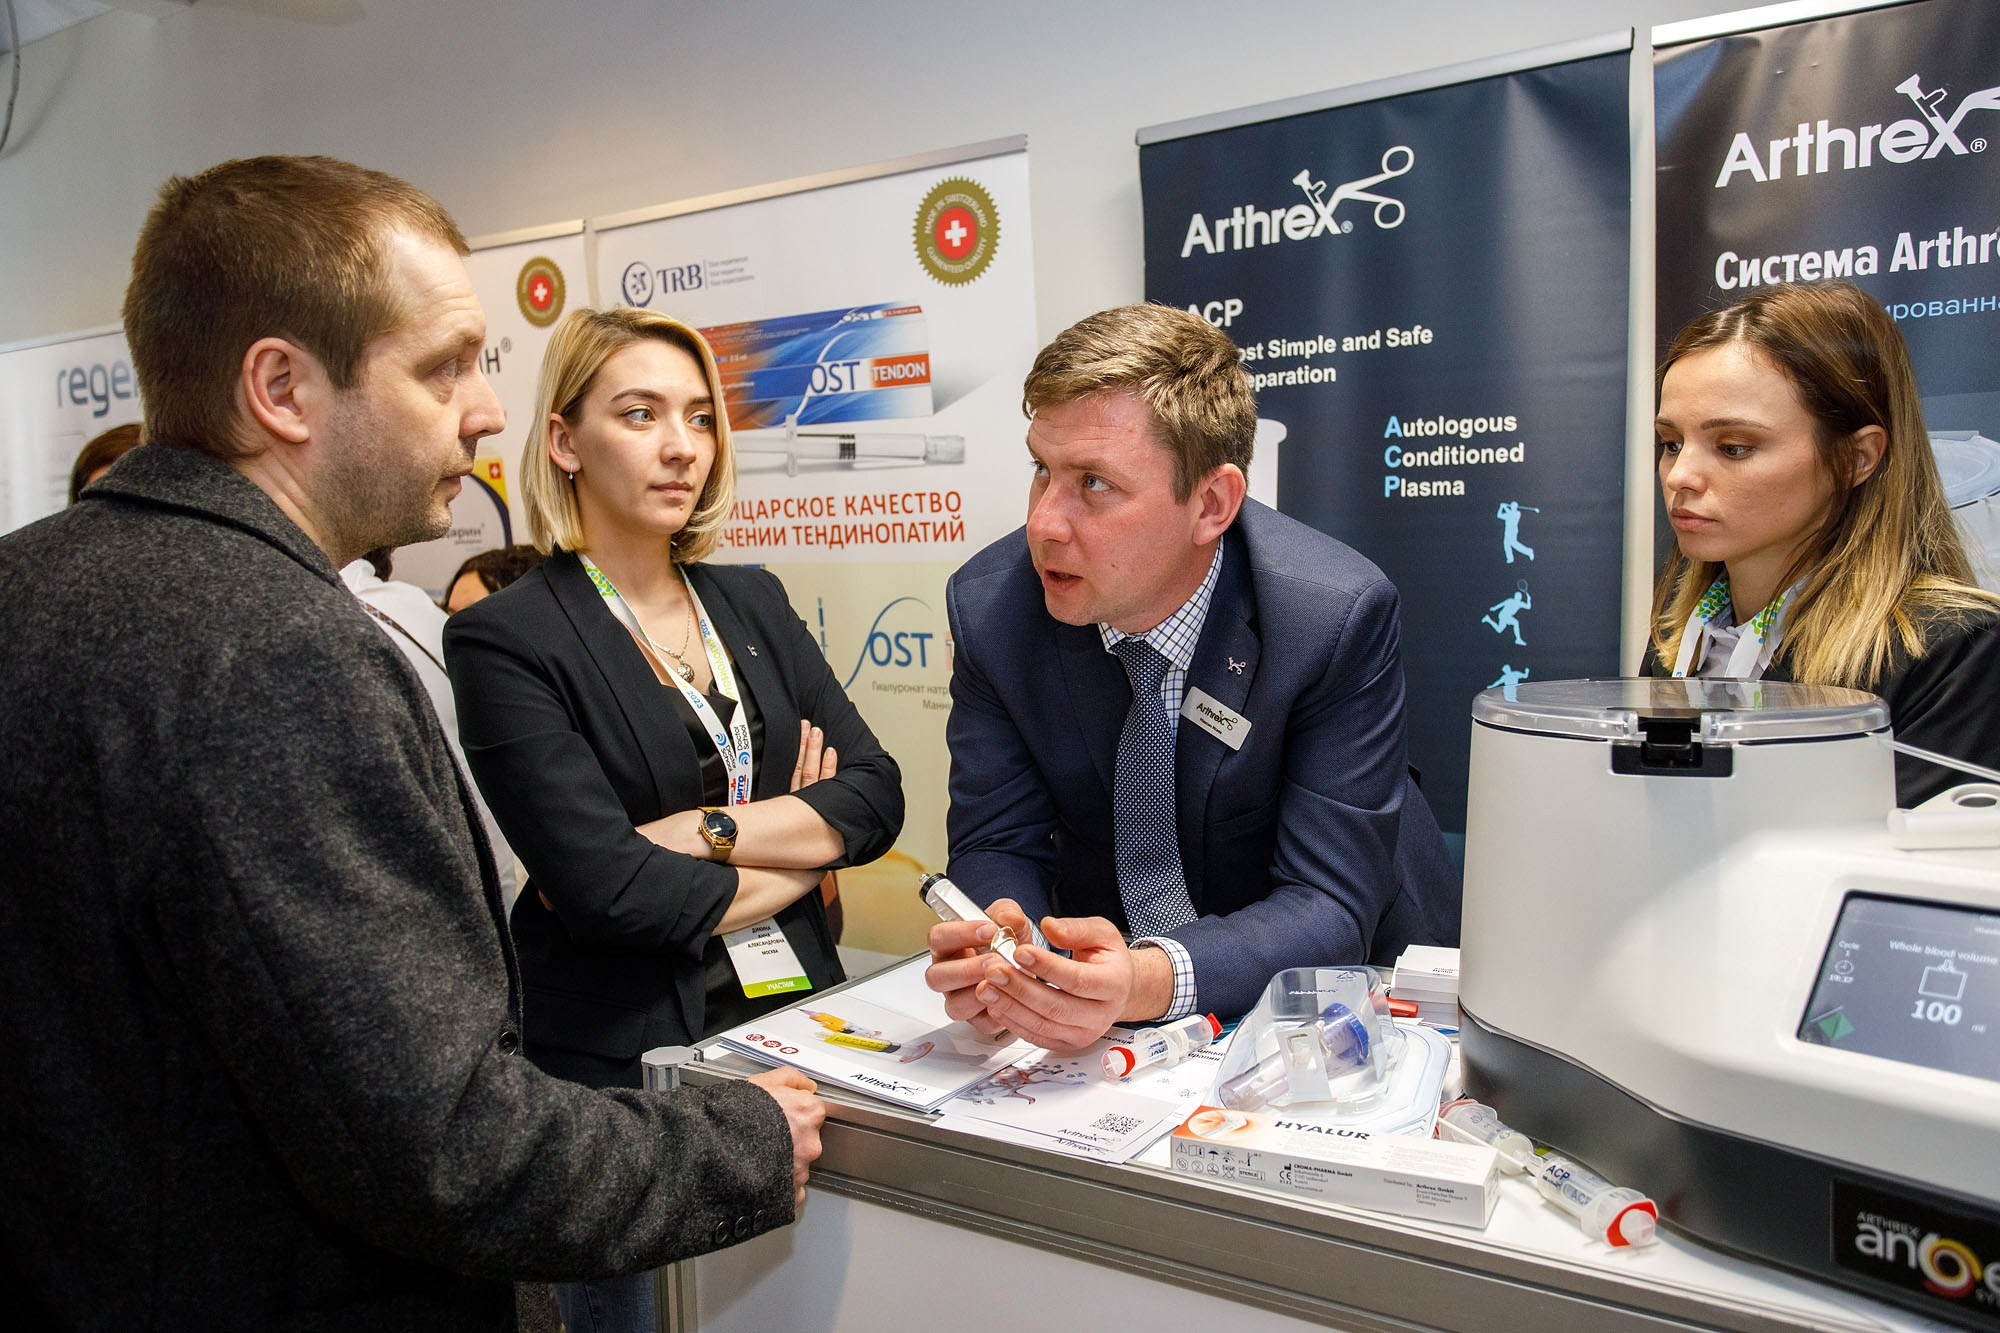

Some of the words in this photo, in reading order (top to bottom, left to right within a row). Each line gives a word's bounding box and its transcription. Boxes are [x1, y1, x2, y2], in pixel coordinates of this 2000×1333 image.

[1715, 74, 1971, 188] Arthrex
[924, 208, 937, 234] MADE
[1181, 169, 1345, 258] Arthrex
[1715, 245, 1878, 290] Система
[1889, 226, 2000, 273] Arthr
[656, 264, 702, 294] TRB
[1885, 295, 2000, 322] рованн
[1267, 334, 1336, 359] Simple
[1342, 329, 1381, 351] and
[1386, 325, 1433, 348] Safe
[811, 360, 860, 394] OST
[872, 362, 926, 381] TENDON
[1384, 413, 1518, 441] Autologous
[1384, 441, 1525, 469] Conditioned
[1384, 474, 1466, 499] Plasma
[844, 490, 962, 518] КАЧЕСТВО
[791, 514, 966, 550] ТЕНДИНОПАТИЙ
[868, 631, 934, 669] OST
[687, 690, 704, 708] 2023
[872, 680, 926, 695] Гиалуронат
[1196, 702, 1226, 726] Arthrex
[733, 726, 744, 751] Doctor
[739, 724, 750, 750] School
[720, 747, 733, 772] School
[725, 744, 737, 769] Doctor
[736, 775, 745, 803] ЦИТО
[747, 938, 785, 948] АЛЕКСАНДРОВНА
[1838, 940, 1860, 950] Cycle
[1889, 940, 1921, 954] Whole
[1924, 944, 1955, 958] blood
[1957, 951, 1998, 965] volume
[766, 980, 795, 991] УЧАСТНИК
[1911, 999, 1963, 1026] 100
[850, 1072, 901, 1092] Arthrex
[1057, 1128, 1102, 1143] Arthrex
[1275, 1120, 1371, 1141] HYALUR
[1546, 1165, 1571, 1180] ACP
[1856, 1211, 1920, 1237] ARTHREX
